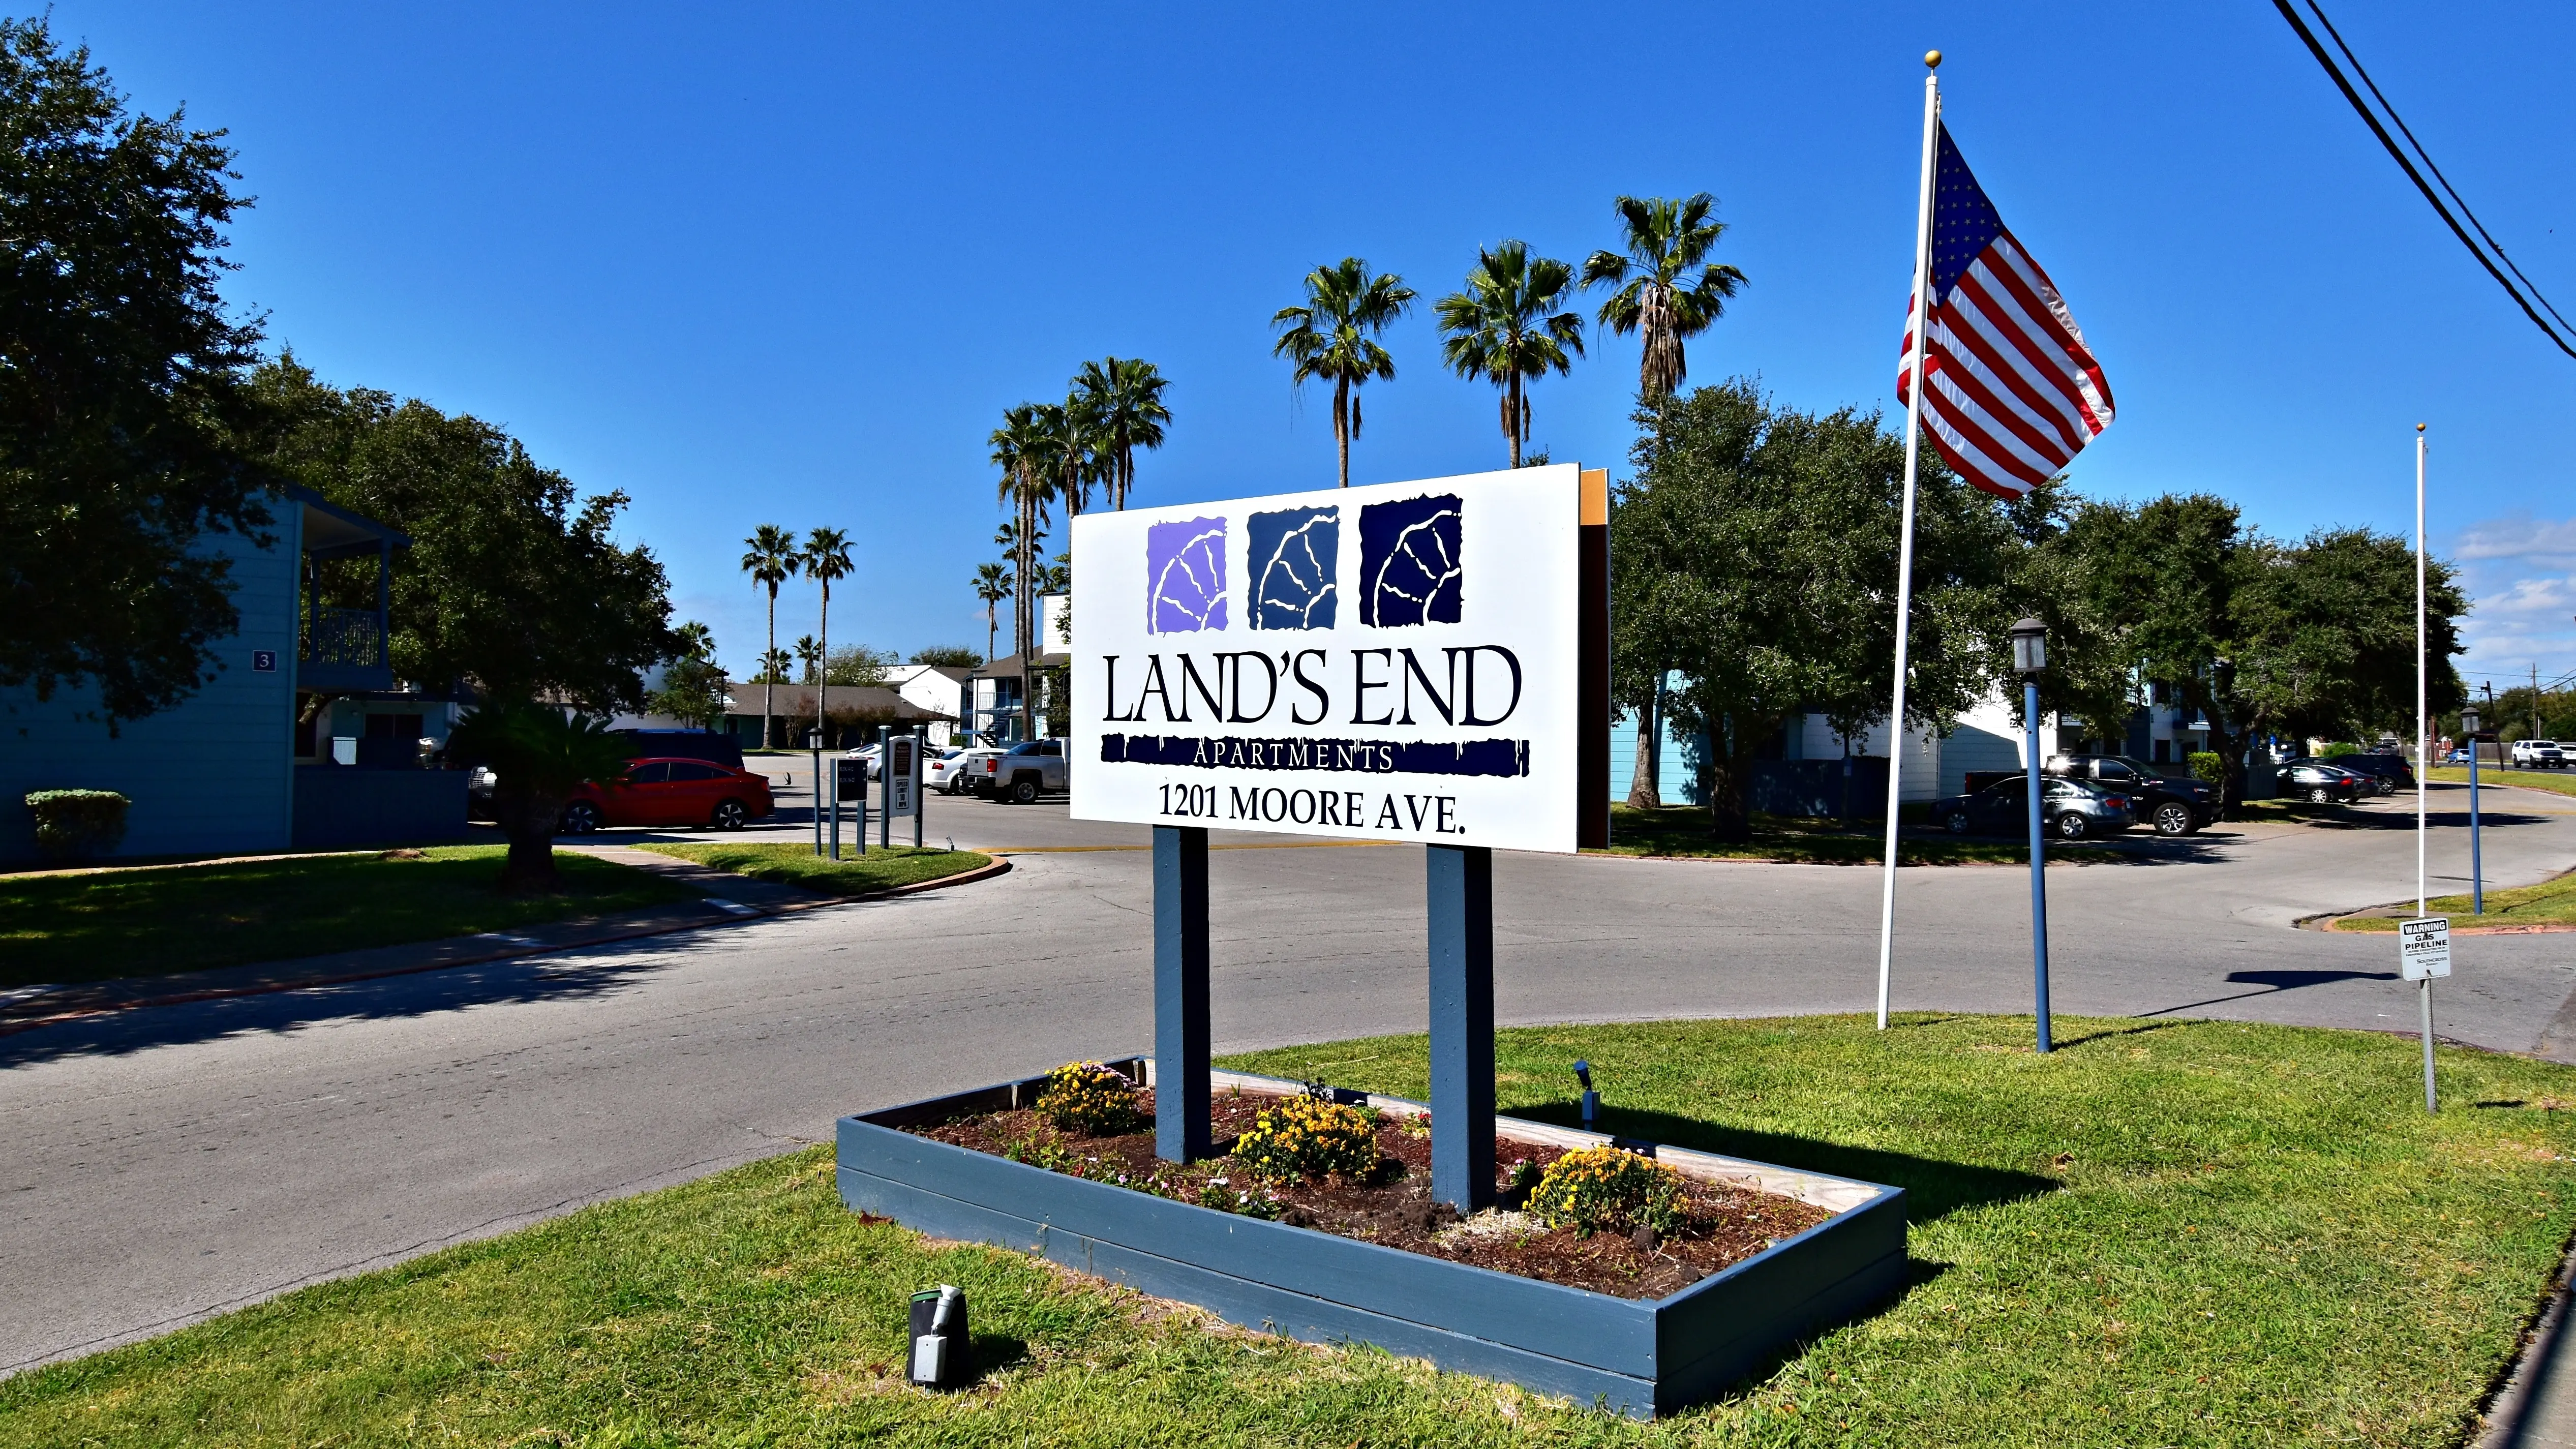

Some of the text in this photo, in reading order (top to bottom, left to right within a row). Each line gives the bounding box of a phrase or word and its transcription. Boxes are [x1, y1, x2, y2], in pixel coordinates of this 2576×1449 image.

[260, 654, 269, 667] 3
[1102, 645, 1522, 727] LAND'S END
[1193, 742, 1393, 770] APARTMENTS
[1159, 783, 1466, 834] 1201 MOORE AVE.
[2405, 921, 2445, 934] WARNING
[2415, 933, 2434, 942] GAS
[2405, 939, 2448, 950] PIPELINE
